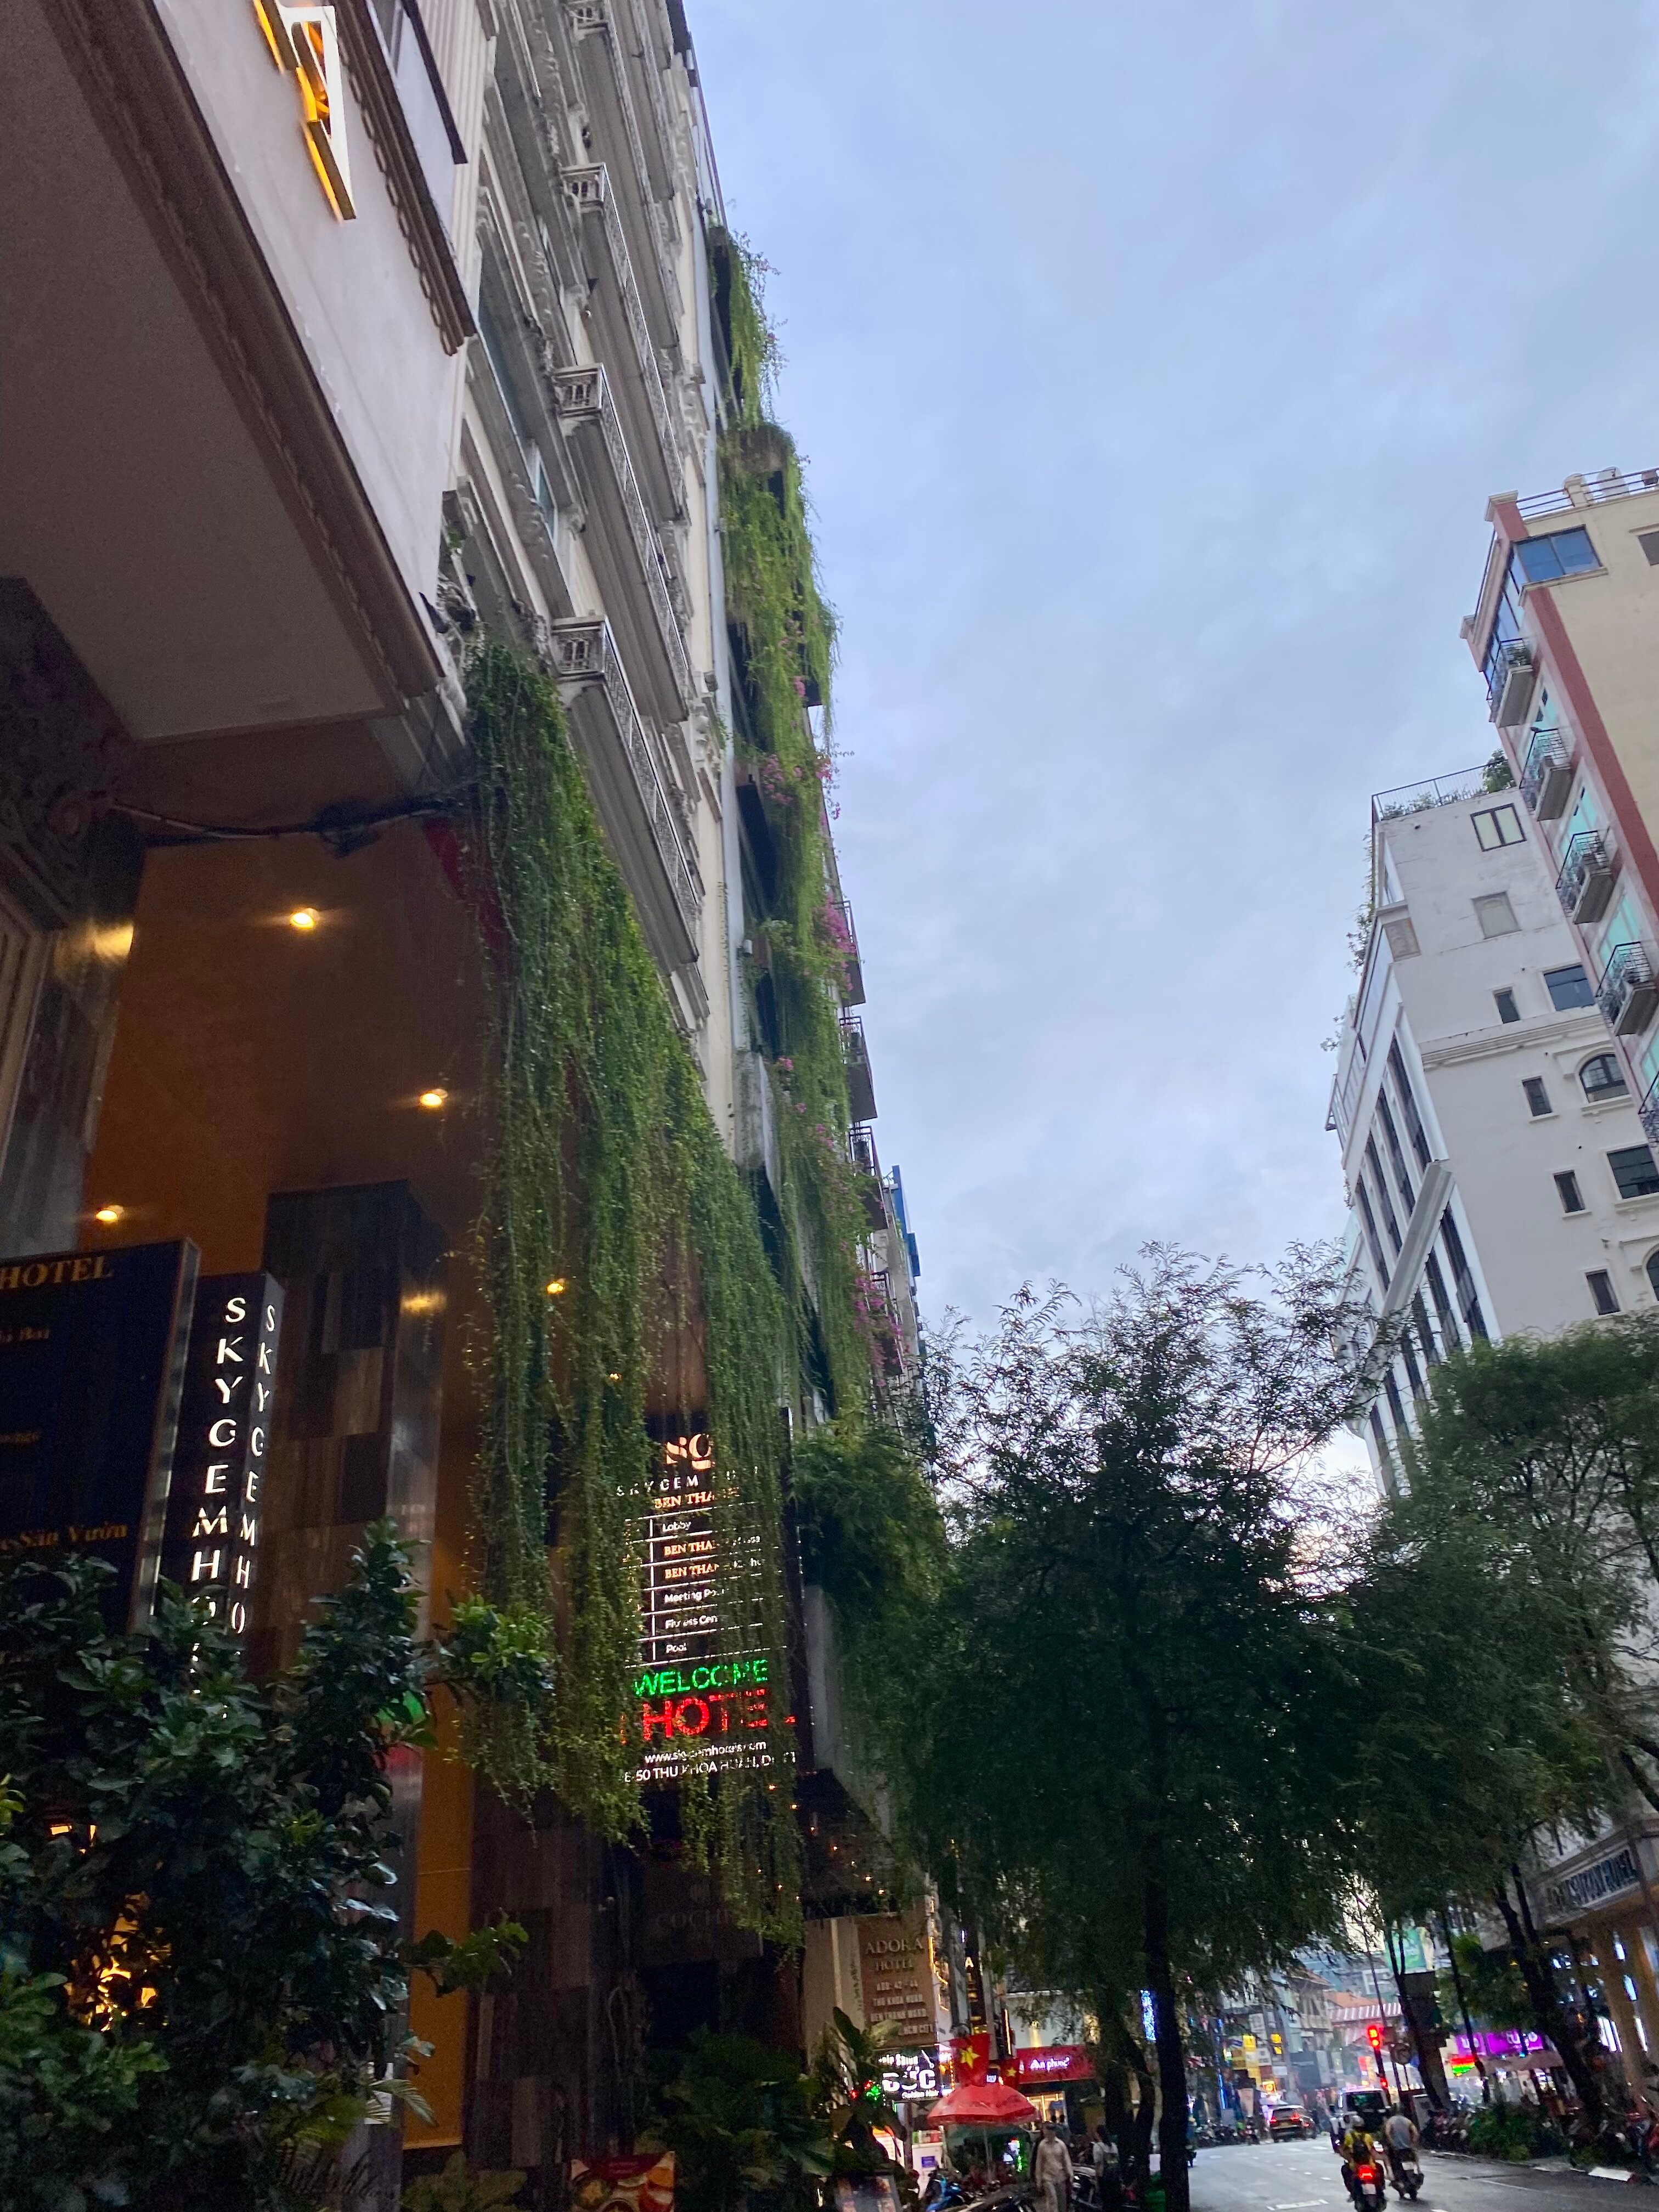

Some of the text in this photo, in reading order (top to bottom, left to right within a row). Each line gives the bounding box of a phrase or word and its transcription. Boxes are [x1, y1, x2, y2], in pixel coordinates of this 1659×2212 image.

[0, 1255, 114, 1289] HOTEL
[654, 1494, 682, 1509] BEN
[662, 1520, 692, 1533] Lobby
[663, 1543, 687, 1556] BEN
[664, 1566, 687, 1579] BEN
[664, 1591, 702, 1604] Meeting
[634, 1658, 769, 1696] WELCOME
[642, 1688, 795, 1742] HOTE
[652, 1765, 679, 1779] THU
[876, 1958, 913, 1971] HOTEL
